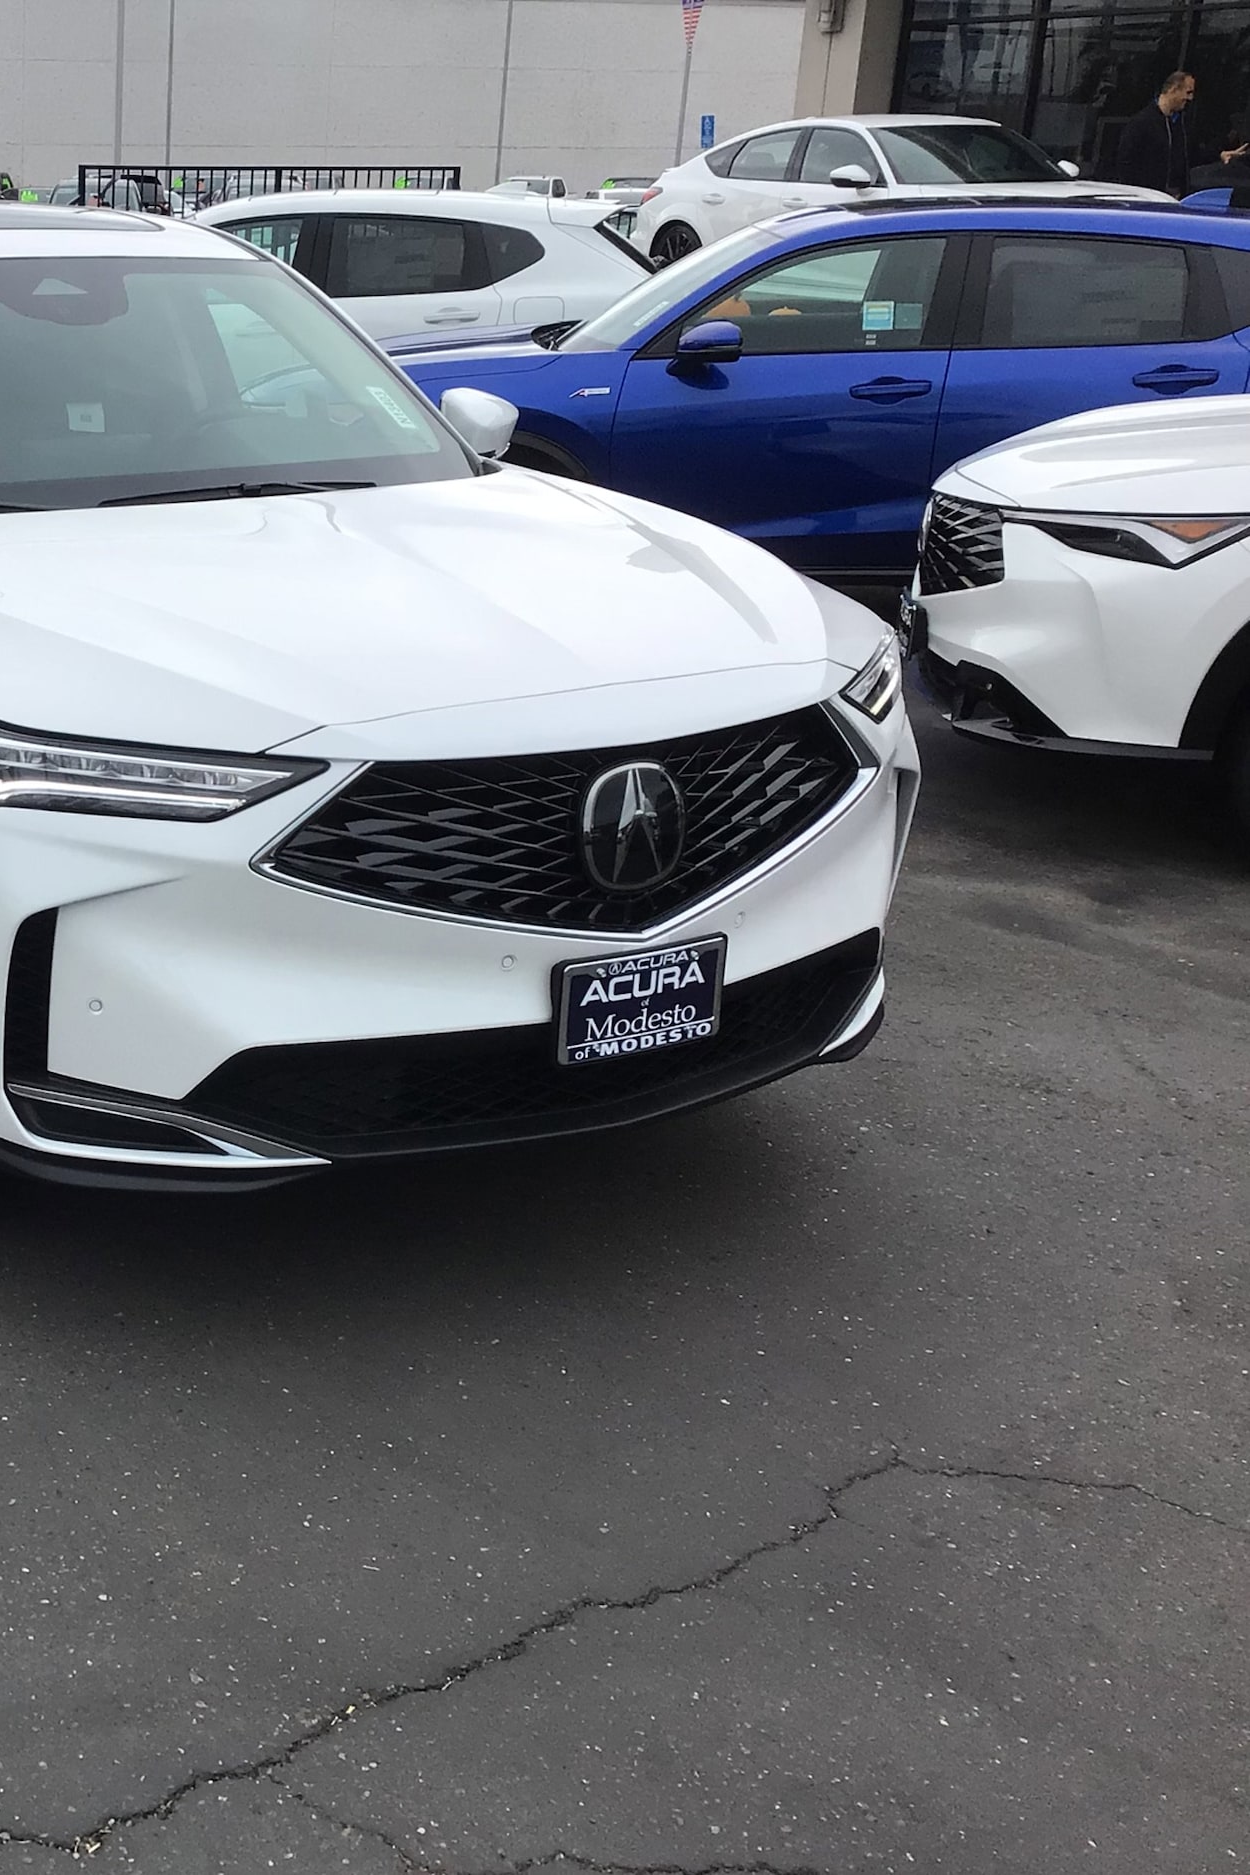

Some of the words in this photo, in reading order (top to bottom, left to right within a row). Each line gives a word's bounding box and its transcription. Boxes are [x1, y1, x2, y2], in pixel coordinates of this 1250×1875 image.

[621, 950, 689, 974] ACURA
[580, 961, 705, 1007] ACURA
[574, 1045, 591, 1061] of
[597, 1022, 712, 1057] MODESTO
[584, 1004, 697, 1042] Modesto
